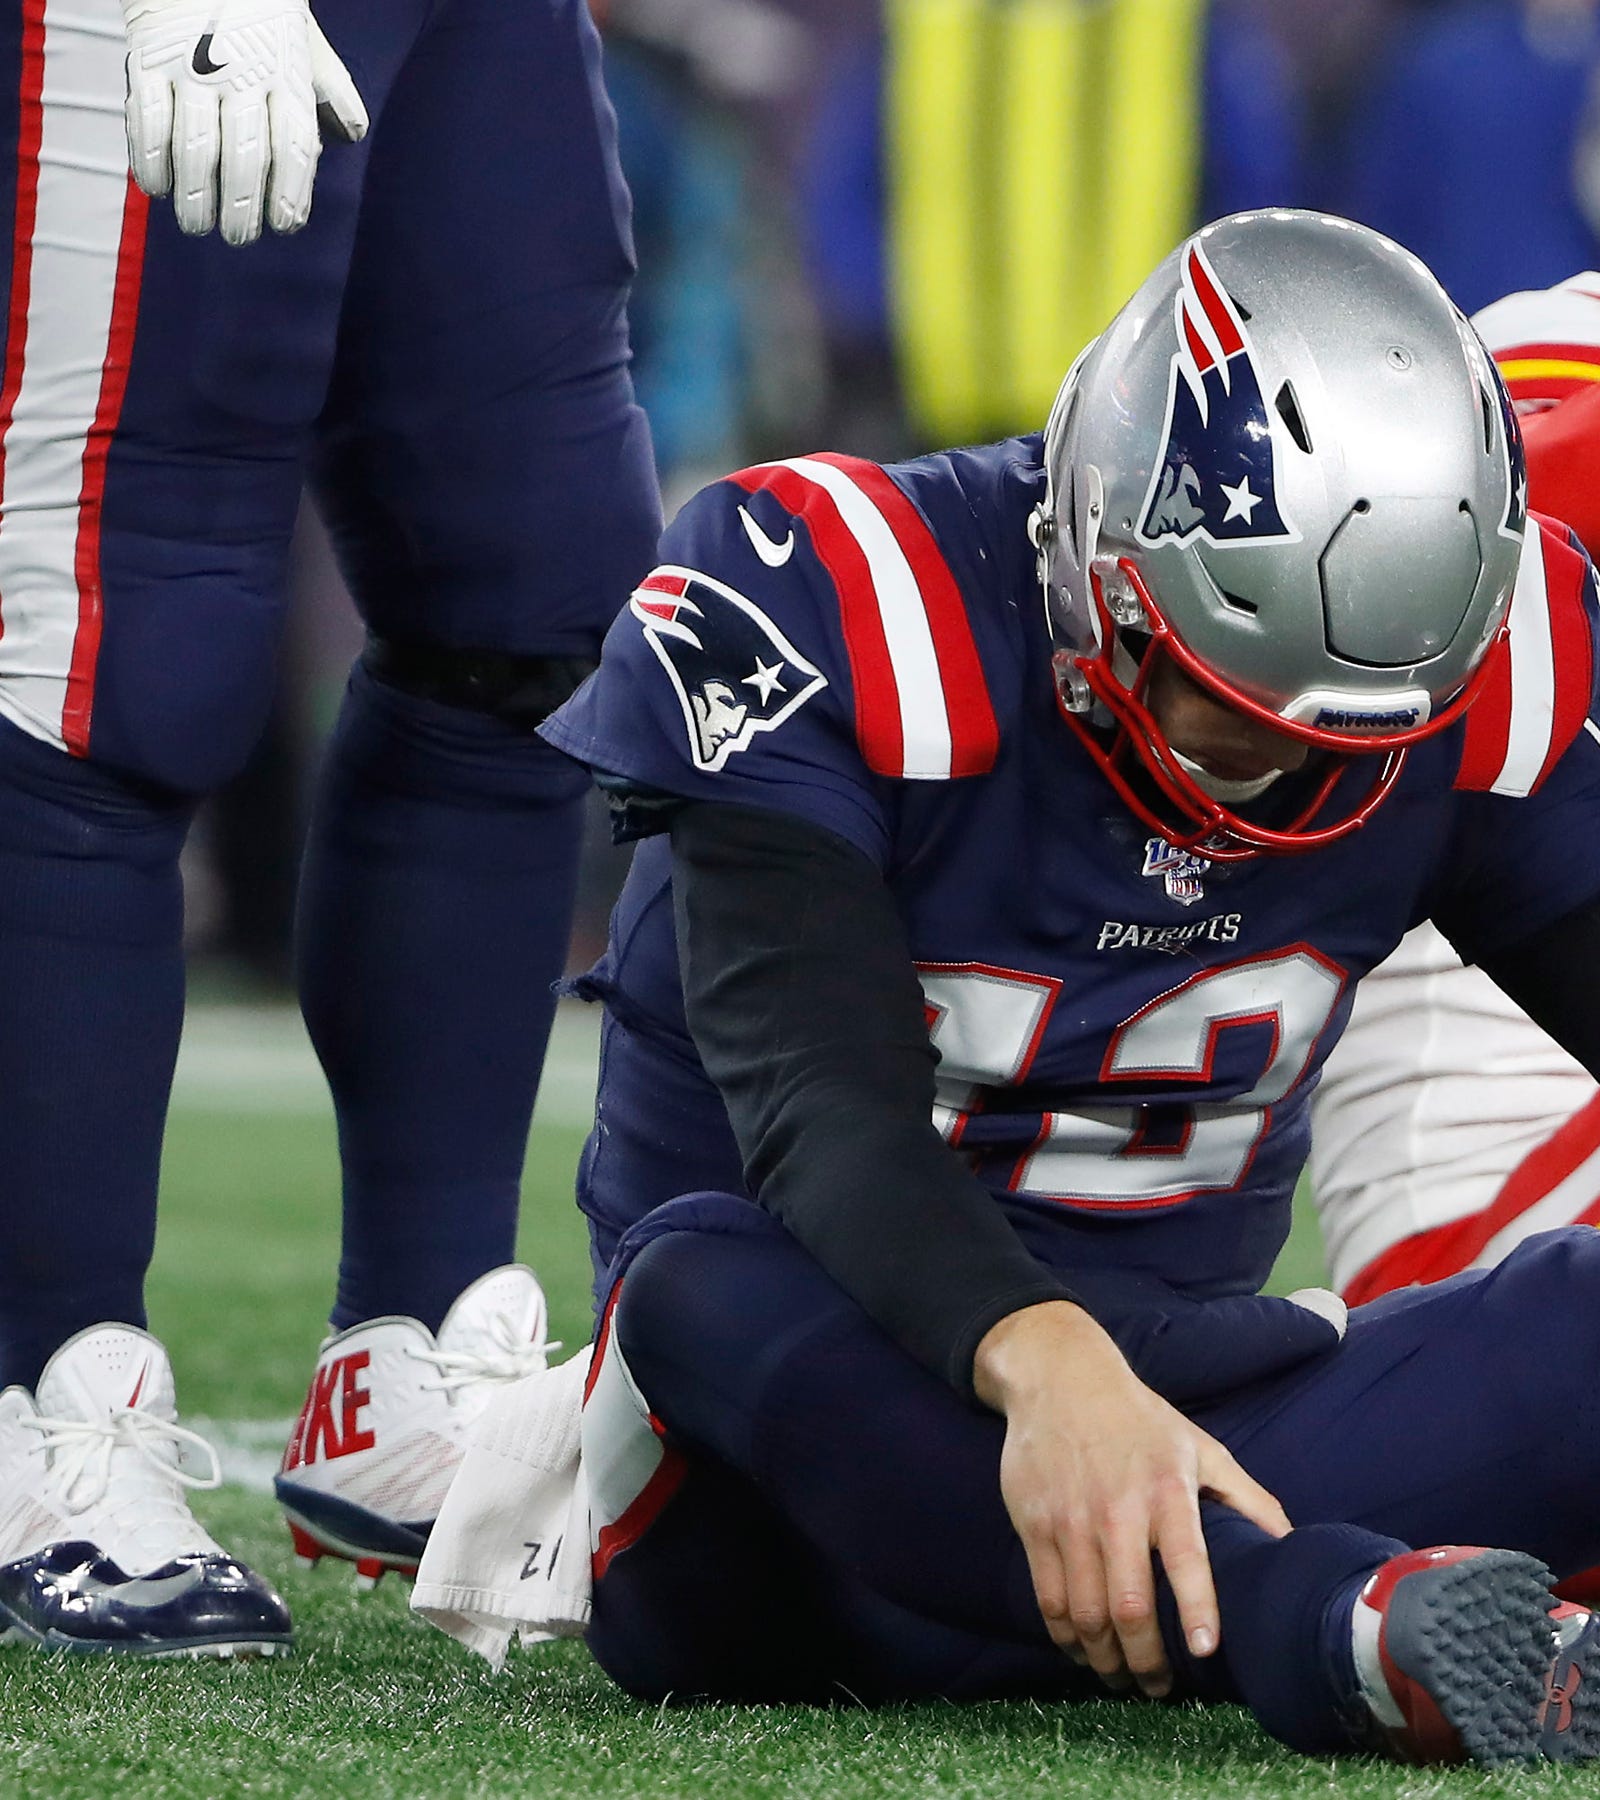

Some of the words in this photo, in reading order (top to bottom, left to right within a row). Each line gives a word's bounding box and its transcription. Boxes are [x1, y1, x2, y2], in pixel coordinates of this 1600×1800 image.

[1312, 707, 1420, 728] PATRIOTS
[1097, 913, 1241, 950] PATRIOTS
[286, 1349, 375, 1471] IKE
